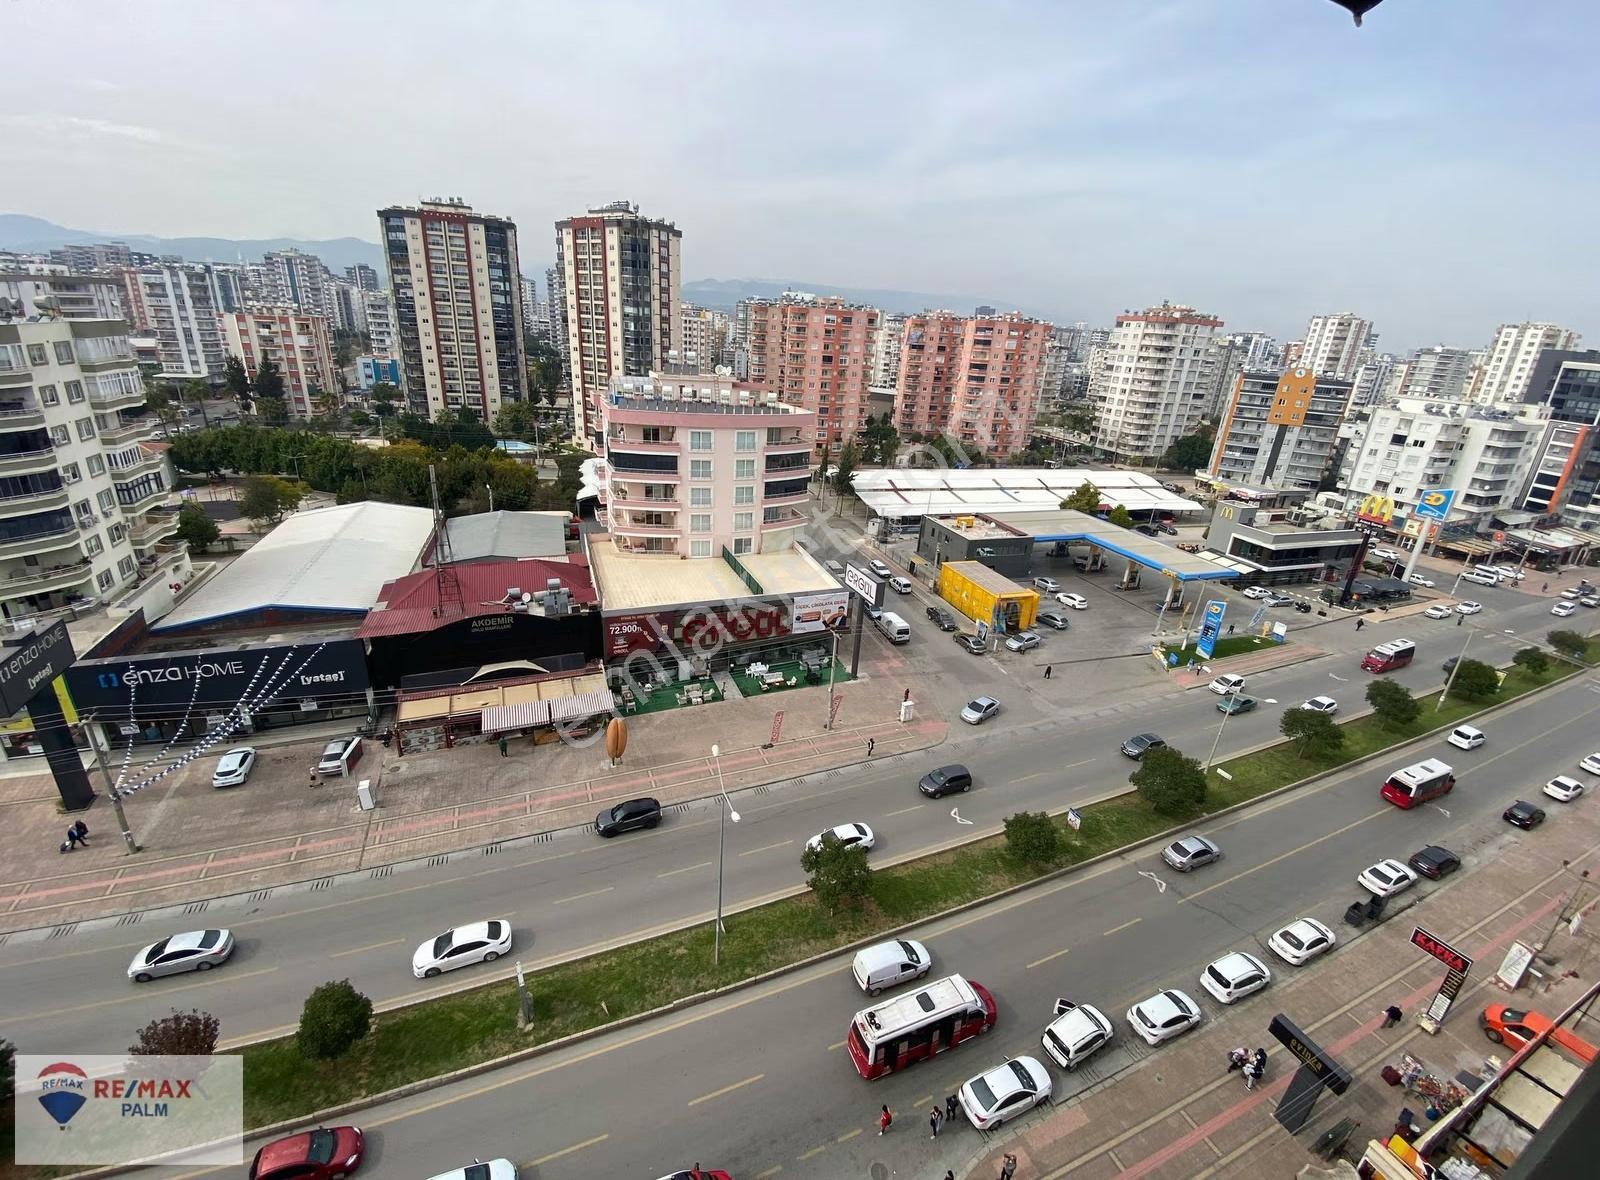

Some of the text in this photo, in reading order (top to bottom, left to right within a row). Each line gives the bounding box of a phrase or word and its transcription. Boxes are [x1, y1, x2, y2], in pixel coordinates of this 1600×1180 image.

[10, 646, 38, 674] enza
[122, 661, 245, 686] enza HOME
